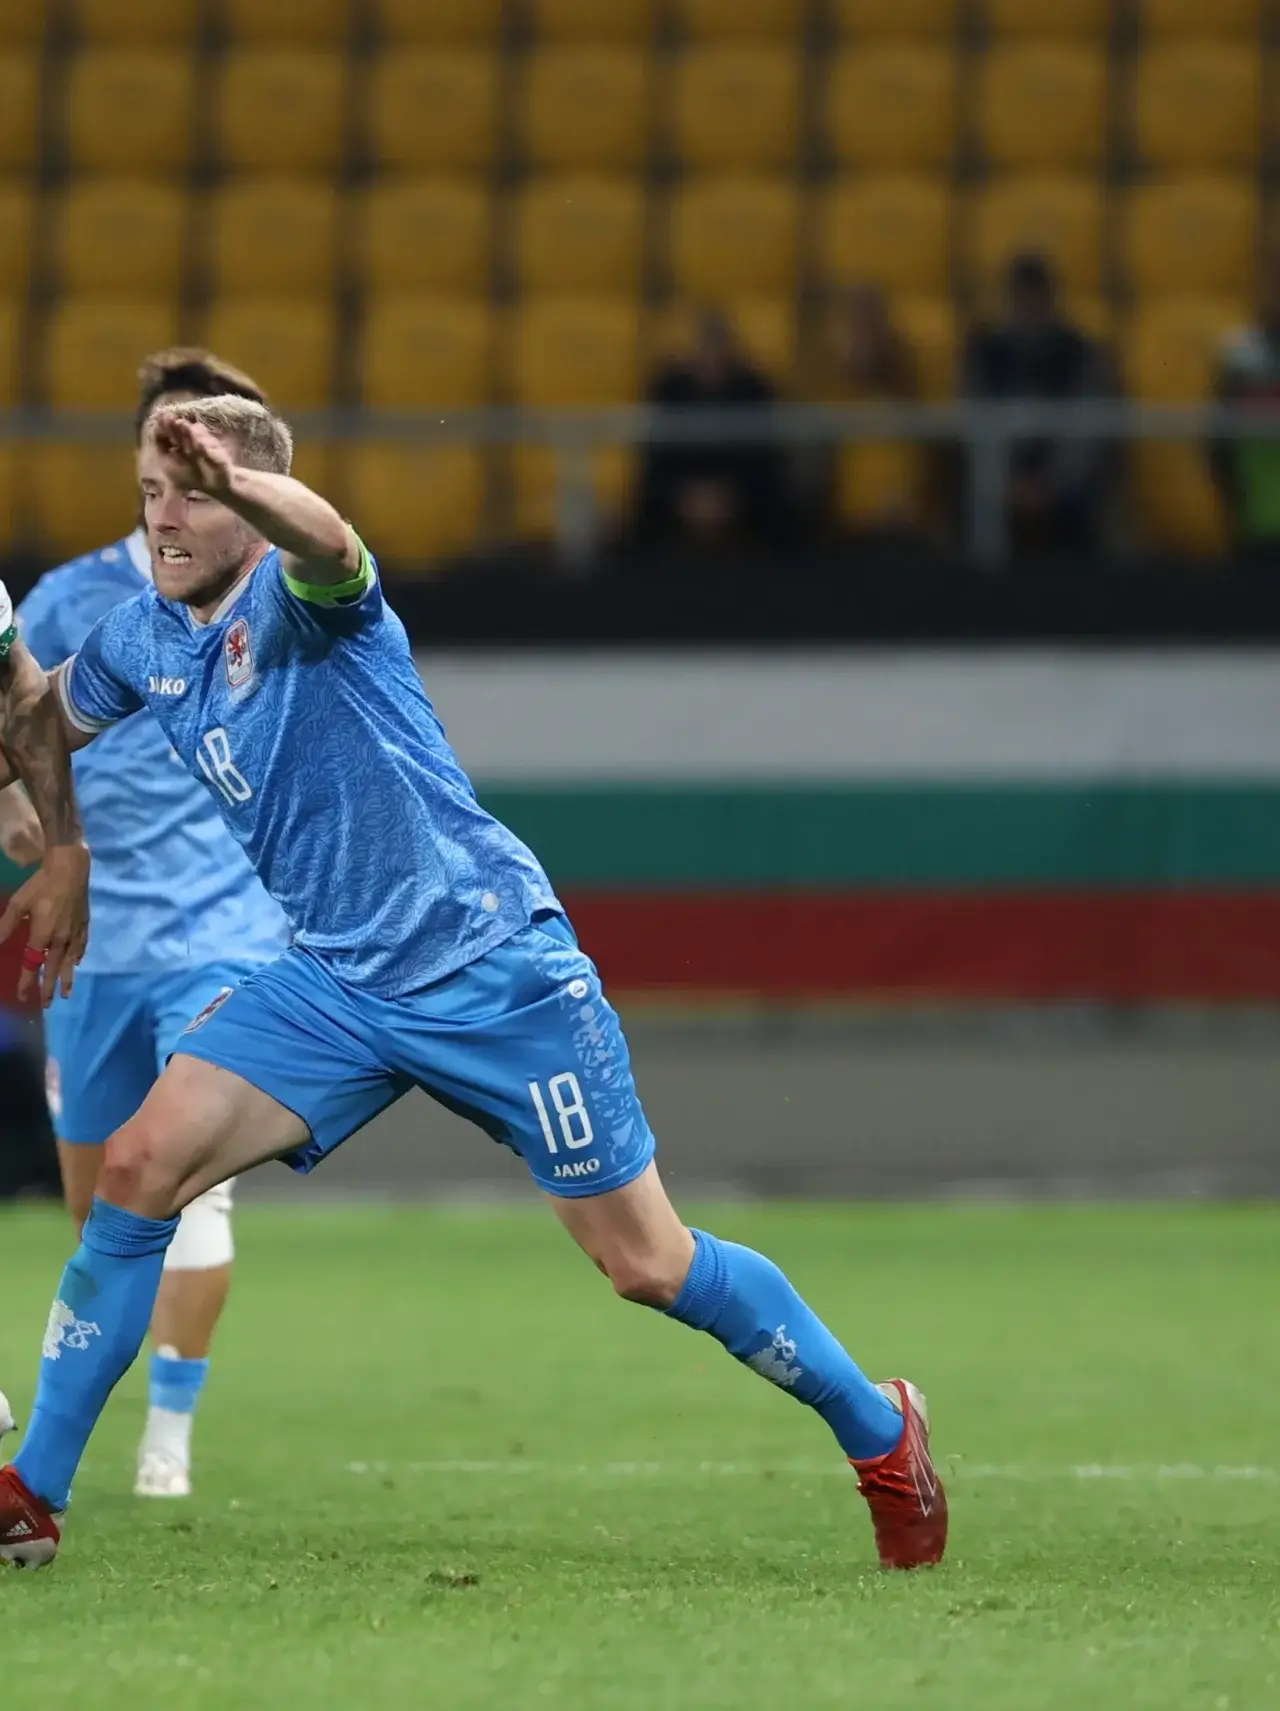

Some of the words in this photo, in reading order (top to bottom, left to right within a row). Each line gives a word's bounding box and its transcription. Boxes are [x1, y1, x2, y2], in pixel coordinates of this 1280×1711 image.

[196, 727, 252, 807] 18
[529, 1071, 594, 1154] 18
[554, 1158, 600, 1177] JAKO
